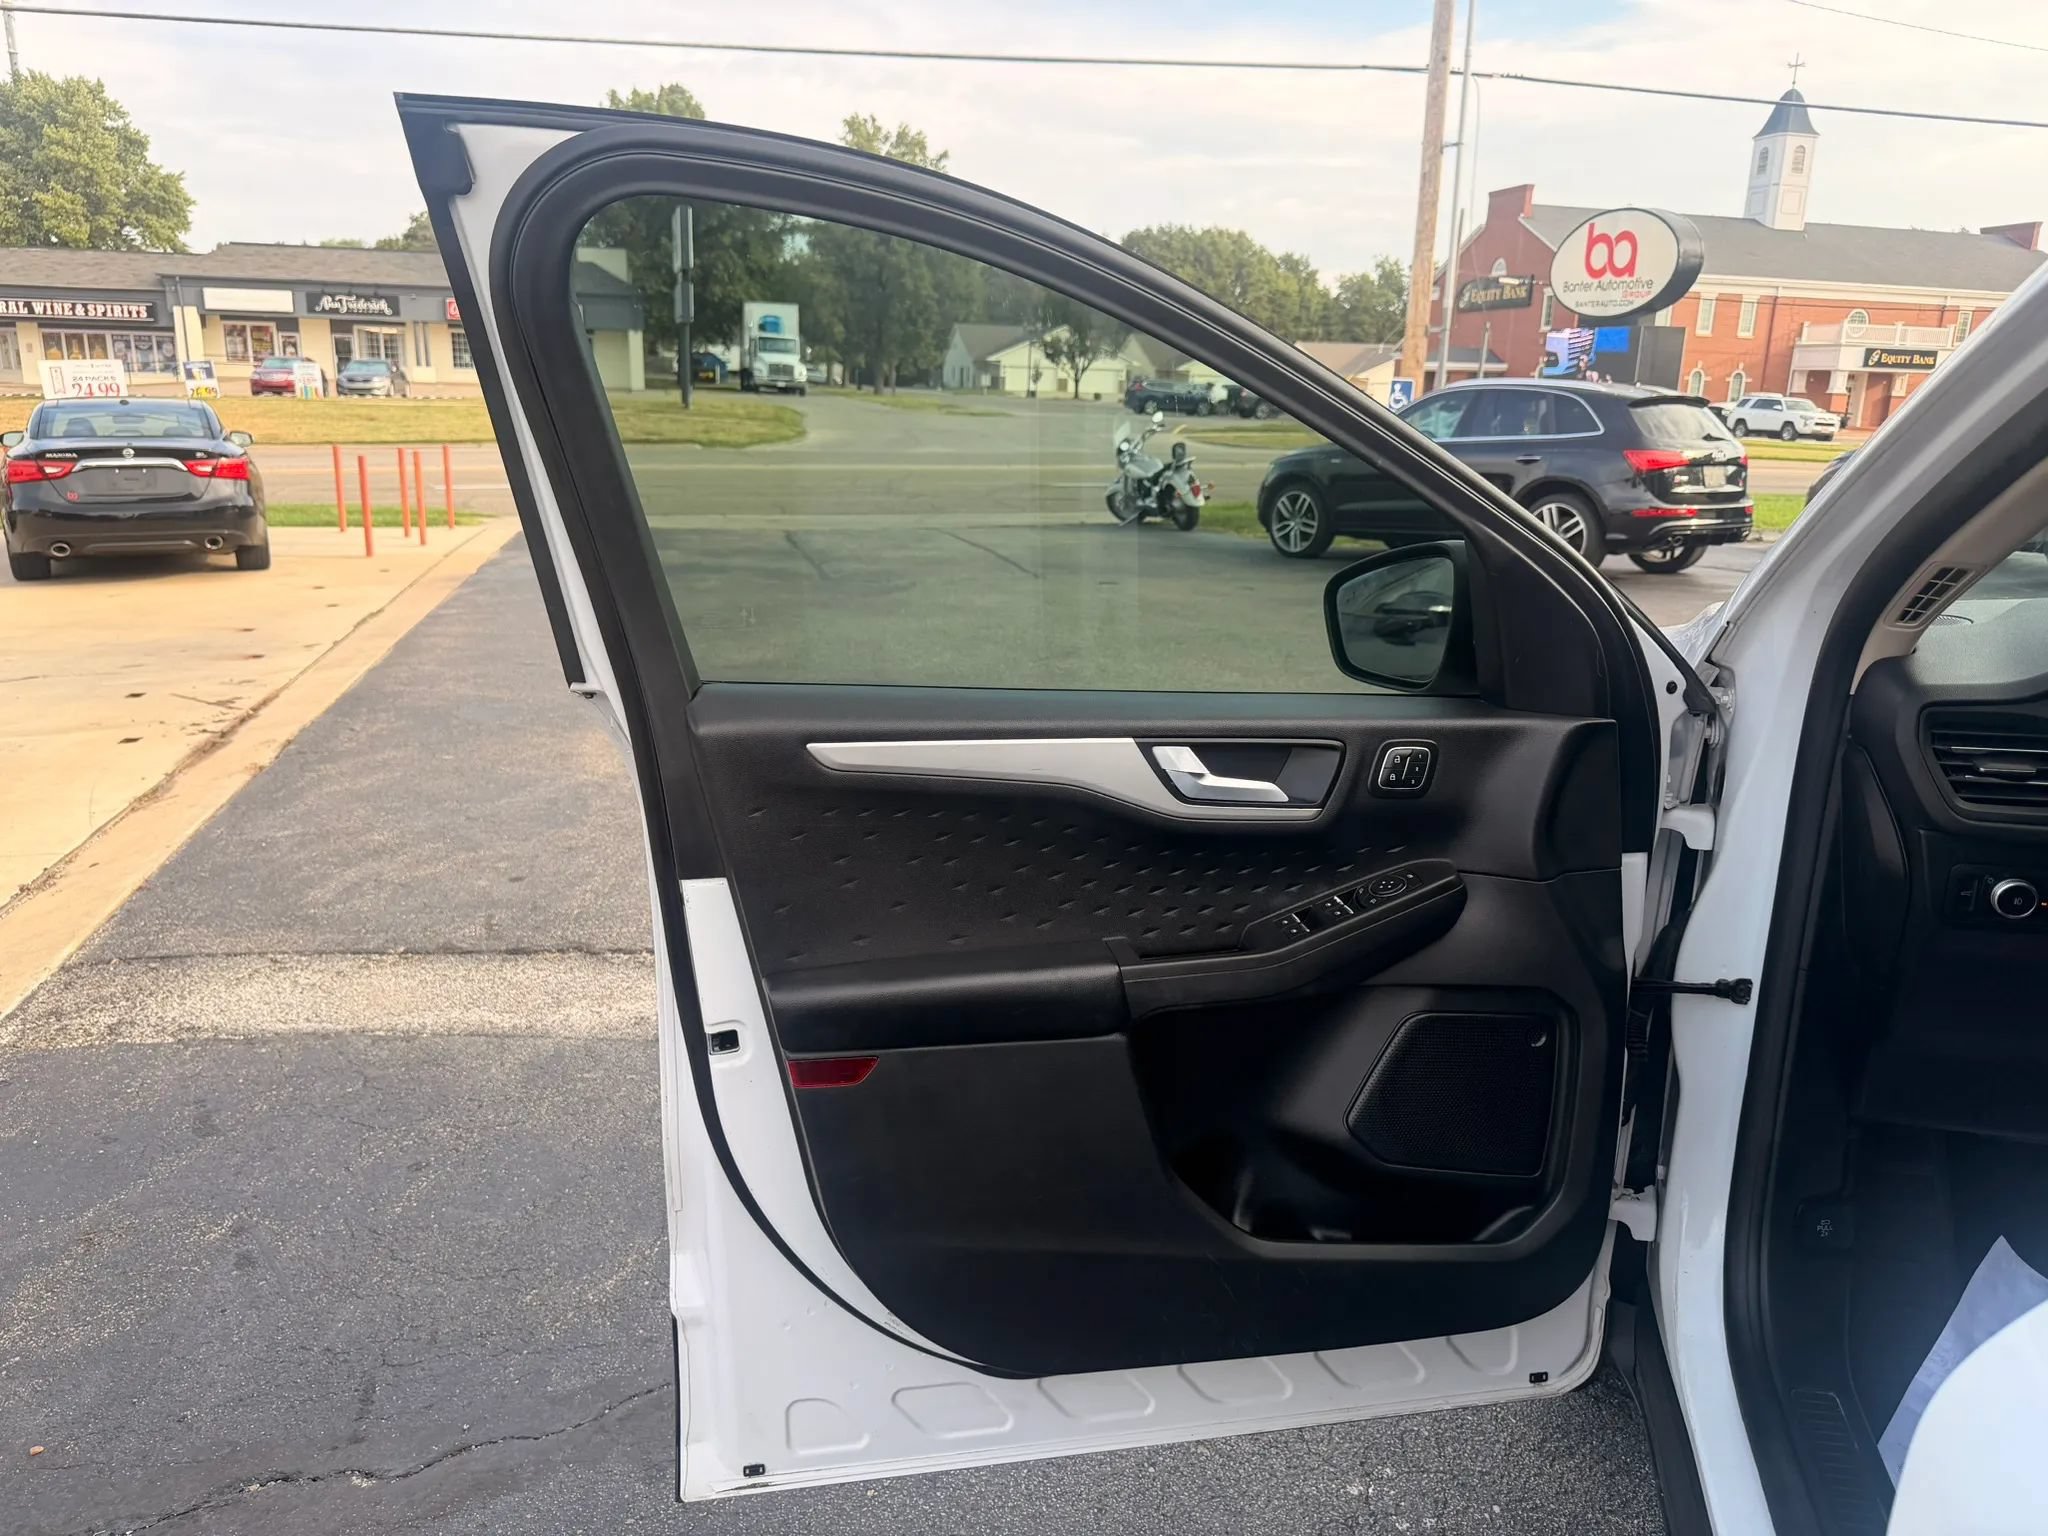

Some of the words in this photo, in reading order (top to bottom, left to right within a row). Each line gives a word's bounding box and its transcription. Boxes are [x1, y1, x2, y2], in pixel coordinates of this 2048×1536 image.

[1563, 281, 1596, 293] Banter
[1597, 278, 1654, 292] Automotive
[32, 302, 73, 316] WINE
[88, 304, 148, 318] SPIRITS
[1881, 353, 1911, 364] EQUITY
[1912, 354, 1935, 365] BANK
